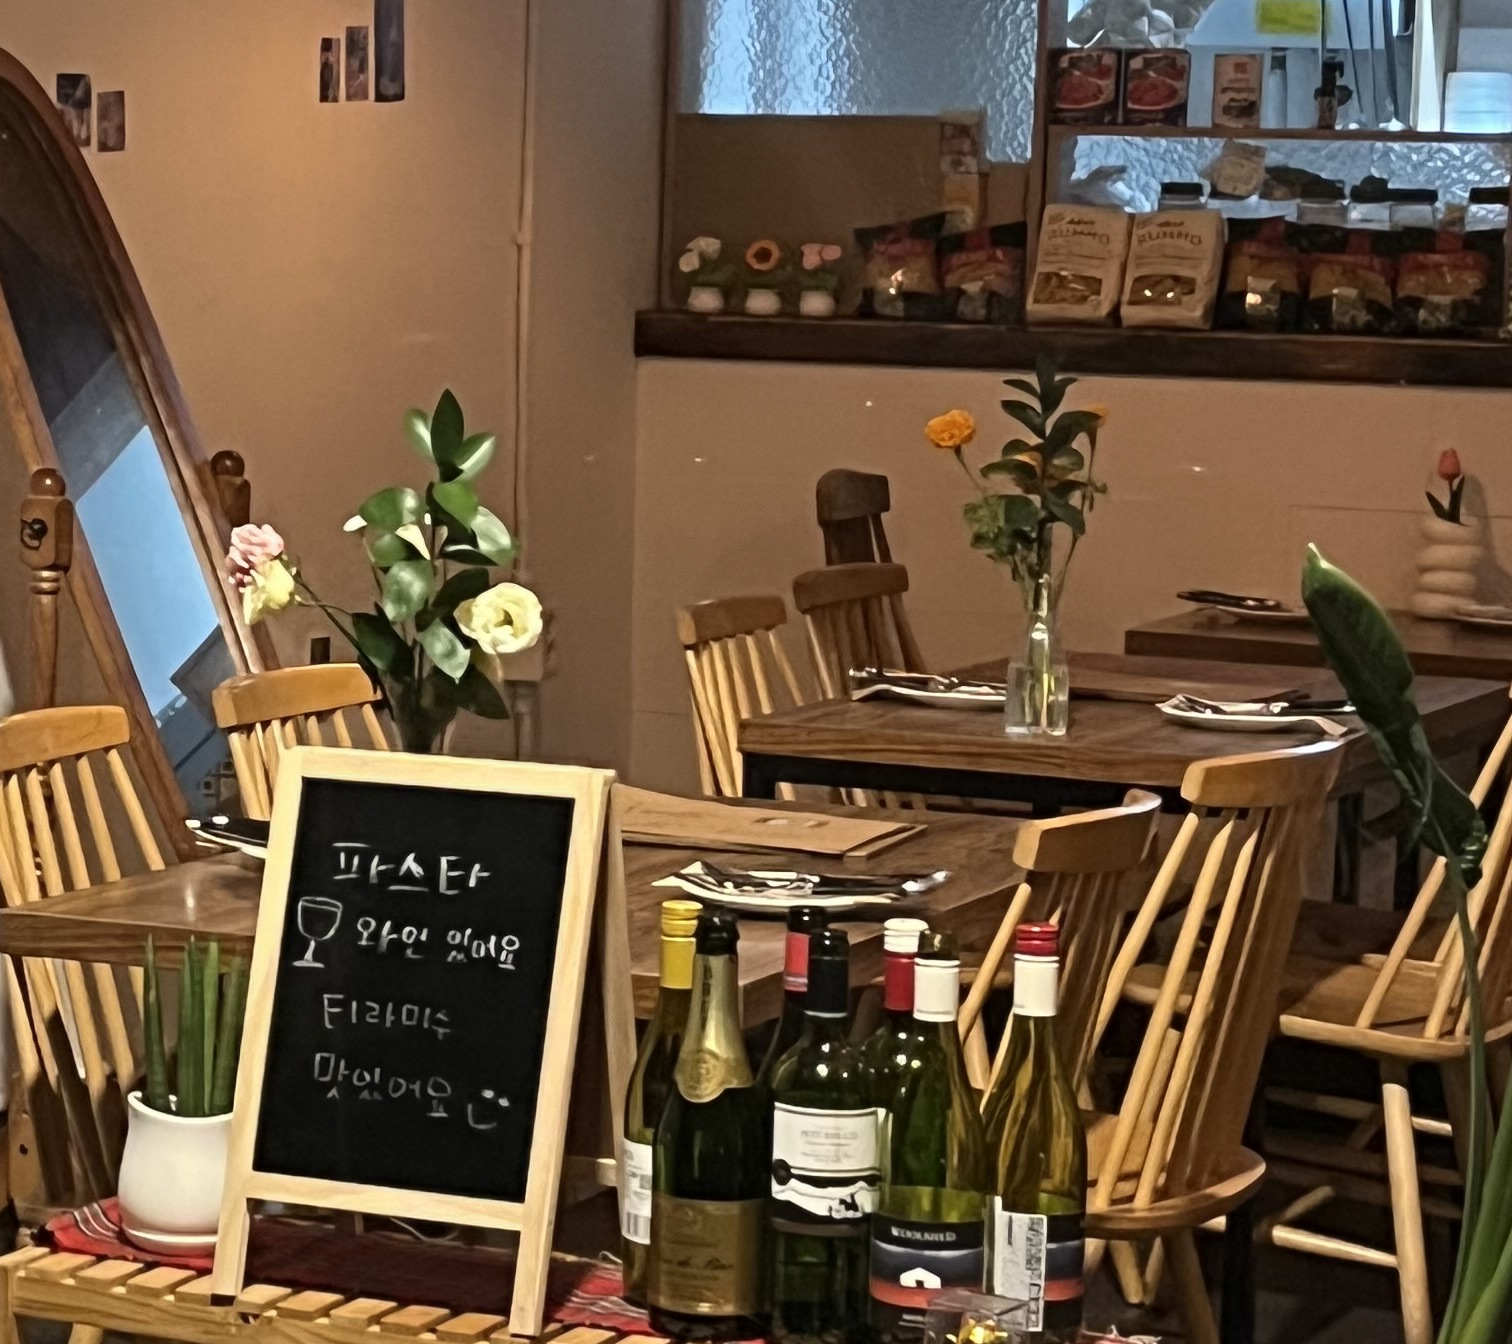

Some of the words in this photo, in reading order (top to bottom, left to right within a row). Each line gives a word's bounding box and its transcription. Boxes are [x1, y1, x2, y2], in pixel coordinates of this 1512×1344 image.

[331, 842, 491, 895] 파스타
[356, 917, 429, 959] 와인
[446, 927, 521, 970] 있어요
[323, 994, 452, 1041] 티라미수
[314, 1052, 452, 1119] 맛있어요
